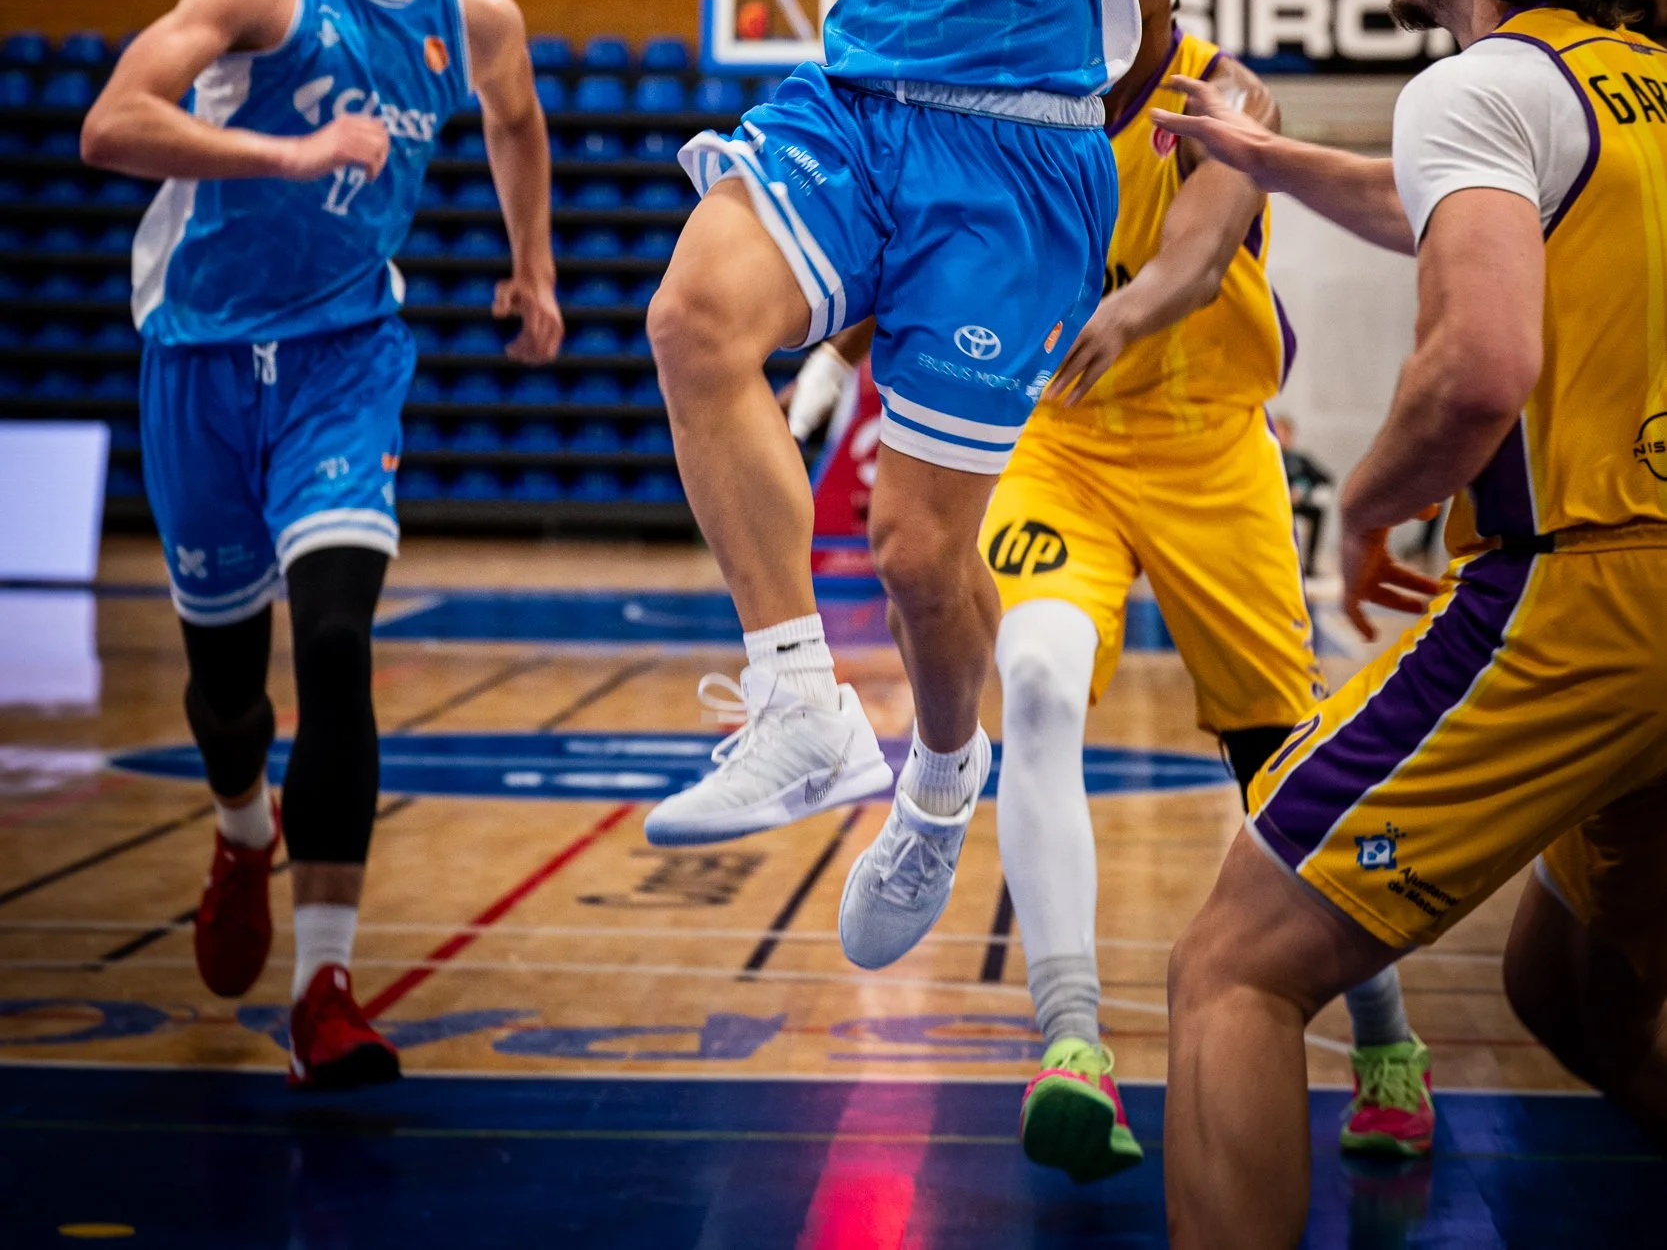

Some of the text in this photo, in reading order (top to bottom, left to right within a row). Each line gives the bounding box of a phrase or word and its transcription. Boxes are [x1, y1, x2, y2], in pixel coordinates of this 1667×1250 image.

[1588, 71, 1667, 126] GAR
[1632, 440, 1667, 459] NIS
[991, 518, 1065, 578] hp
